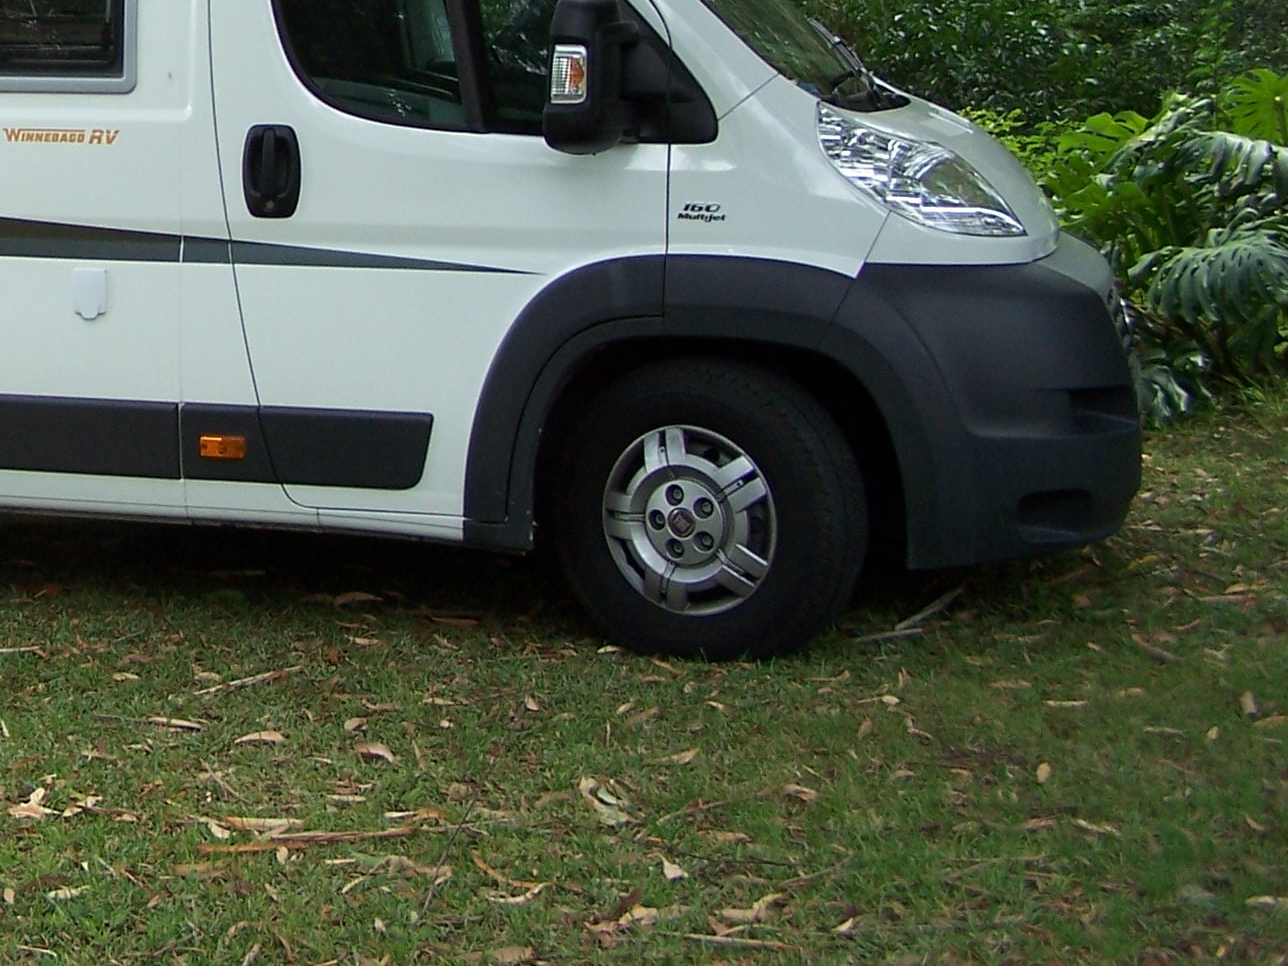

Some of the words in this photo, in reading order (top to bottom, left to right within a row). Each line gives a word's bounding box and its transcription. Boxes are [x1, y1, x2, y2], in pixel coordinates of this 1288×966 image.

[88, 129, 120, 145] RV
[683, 203, 721, 213] 160
[677, 213, 726, 223] Multijet
